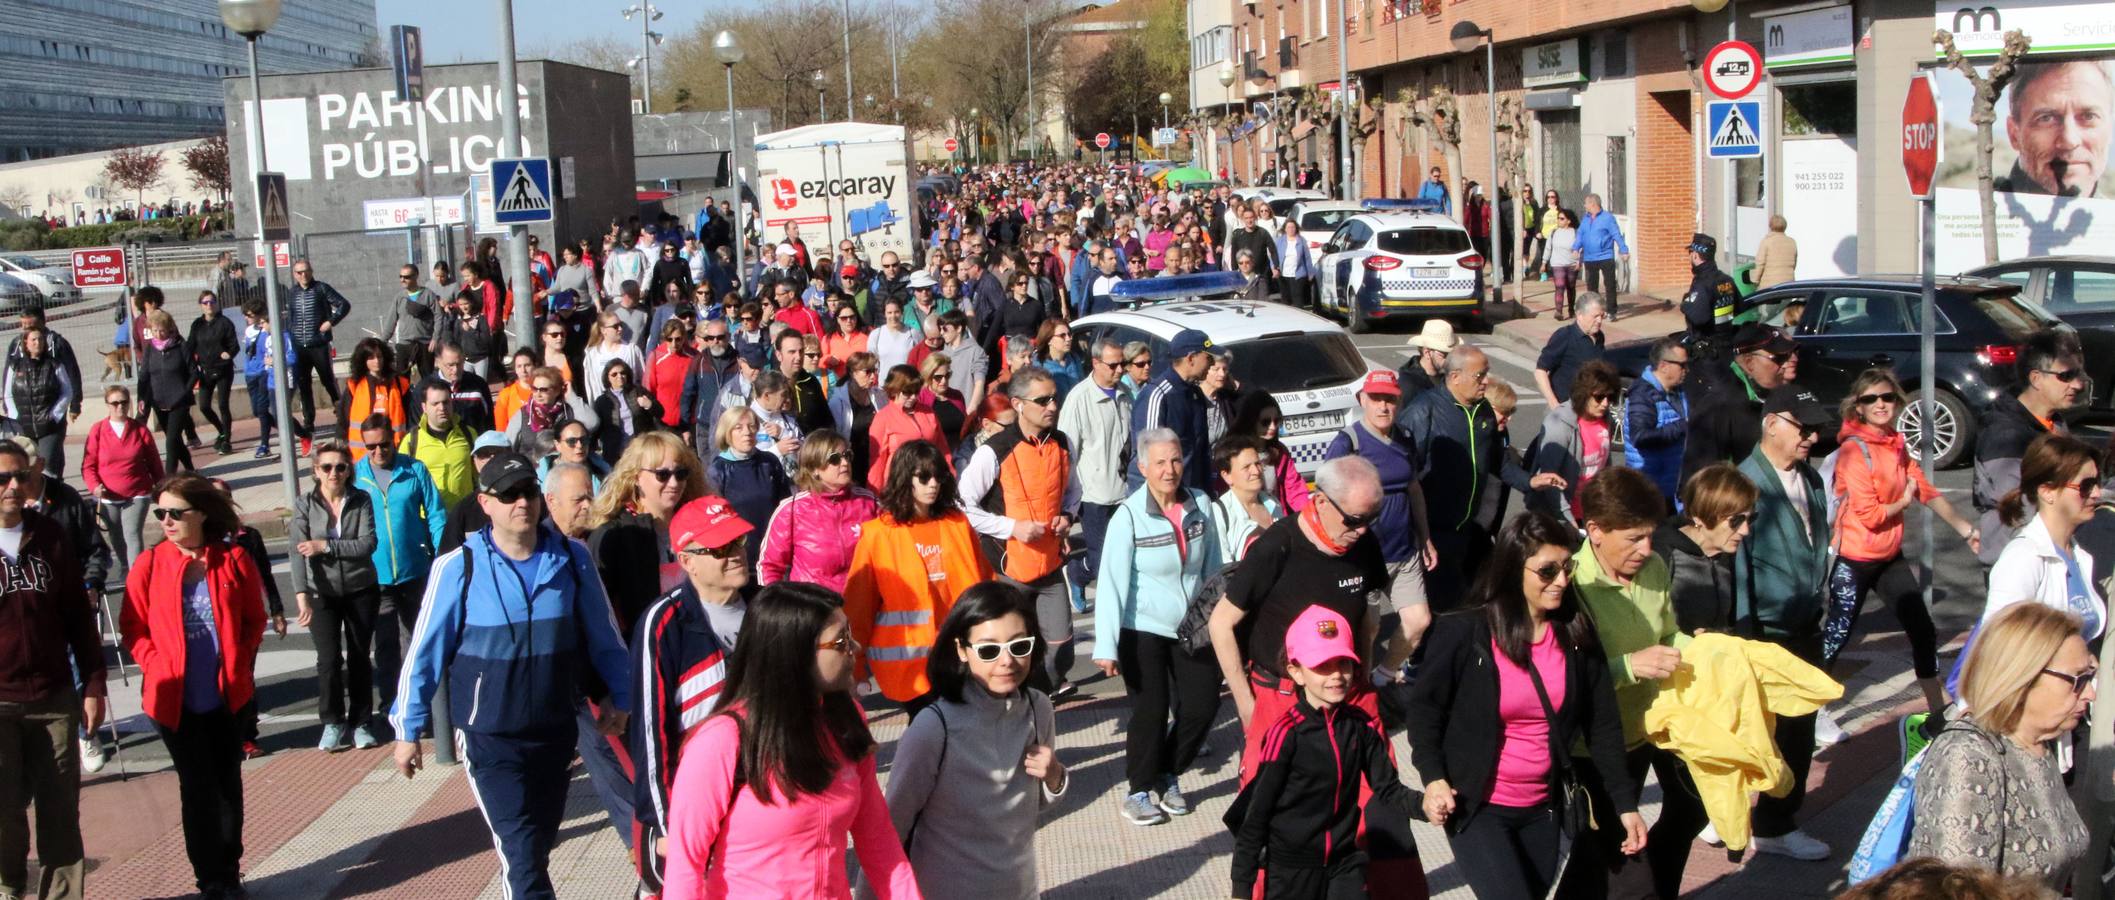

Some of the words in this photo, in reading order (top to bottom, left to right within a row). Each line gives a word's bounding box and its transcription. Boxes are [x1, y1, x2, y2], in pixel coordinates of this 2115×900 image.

[1905, 122, 1935, 150] STOP
[1795, 173, 1809, 181] 941
[1811, 173, 1827, 181] 255
[1828, 173, 1844, 181] 022
[800, 175, 896, 199] ezcaray
[1794, 182, 1810, 190] 900
[1812, 182, 1826, 190] 231
[89, 254, 112, 264] Calle
[1284, 415, 1316, 431] 6846
[1320, 411, 1342, 427] JTM
